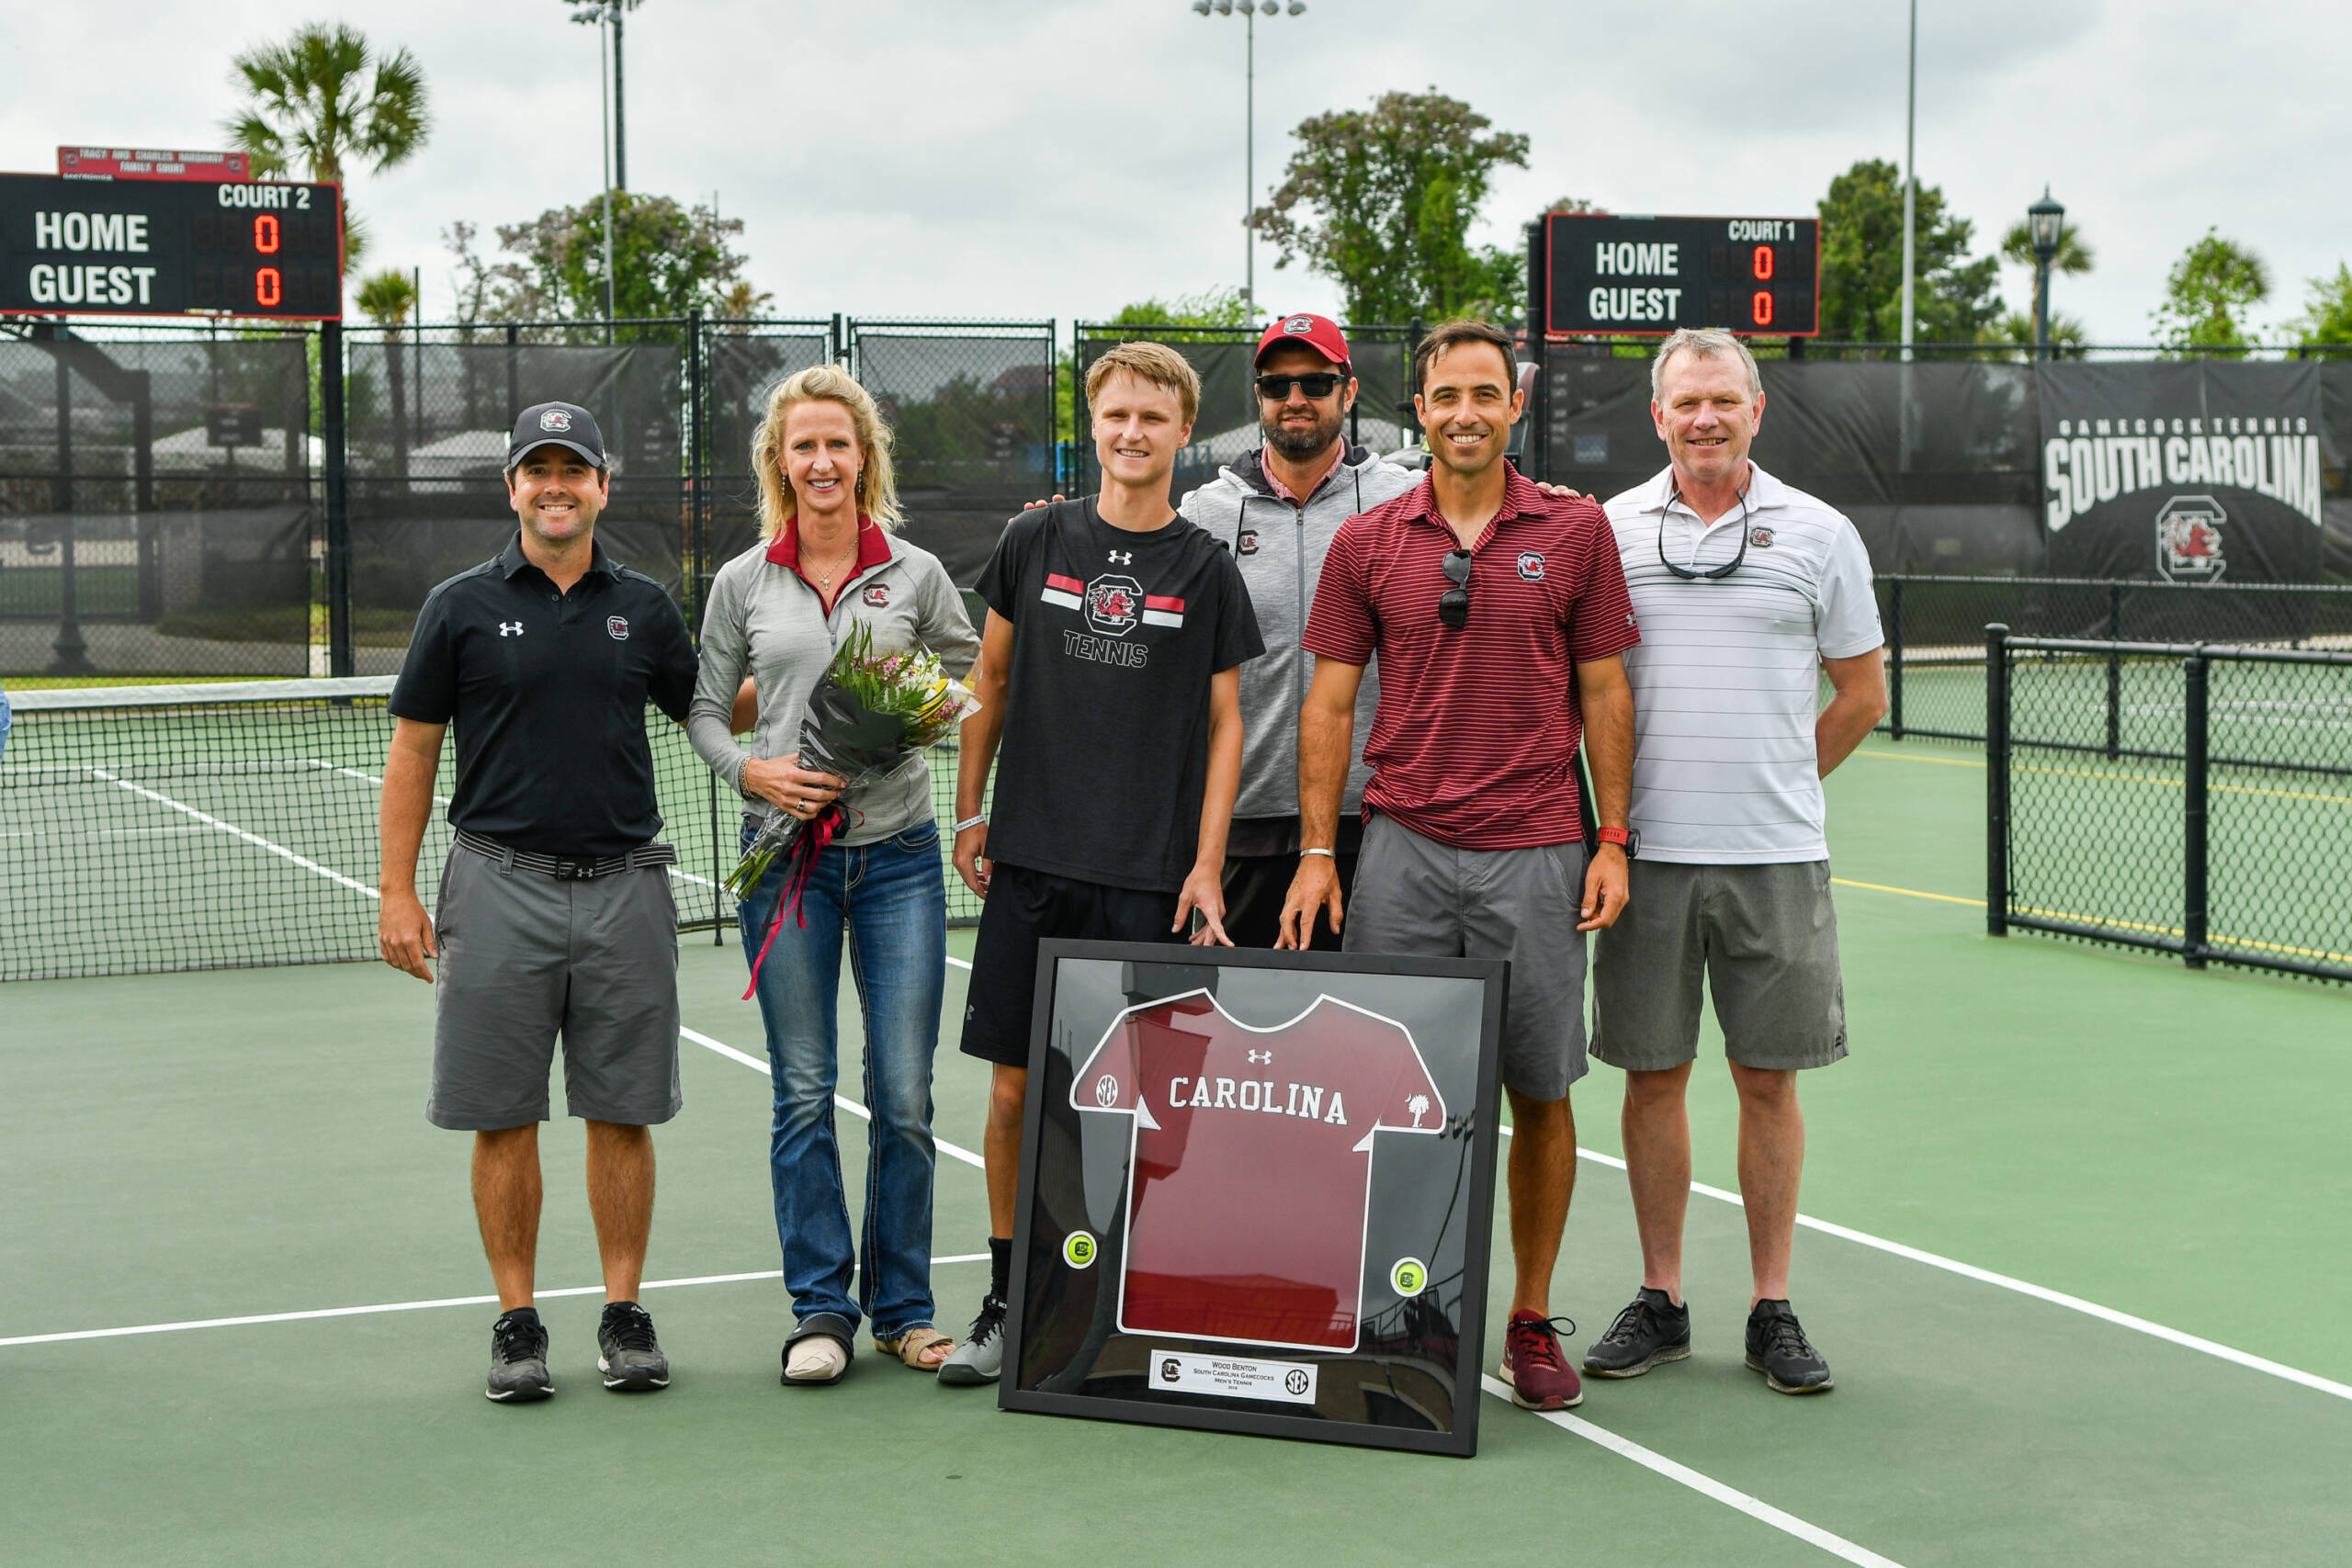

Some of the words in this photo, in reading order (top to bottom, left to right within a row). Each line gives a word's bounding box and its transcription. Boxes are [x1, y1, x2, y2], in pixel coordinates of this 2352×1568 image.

[112, 149, 131, 161] AND
[119, 161, 152, 173] FAMILY
[219, 184, 292, 209] COURT
[296, 187, 311, 209] 2
[35, 211, 150, 253] HOME
[254, 214, 279, 254] 0
[1728, 220, 1783, 241] COURT
[1785, 221, 1795, 241] 1
[1596, 242, 1679, 276] HOME
[1753, 245, 1774, 280] 0
[29, 264, 156, 305] GUEST
[255, 267, 281, 307] 0
[1589, 287, 1682, 321] GUEST
[1753, 290, 1774, 326] 0
[2058, 418, 2203, 436] GAMECOCK
[2212, 416, 2308, 435] TENNIS
[2045, 436, 2163, 533] SOUTH
[2165, 435, 2323, 528] CAROLINA
[1063, 629, 1148, 669] TENNIS
[1168, 1076, 1348, 1125] CAROLINA
[1287, 1371, 1307, 1393] SEC
